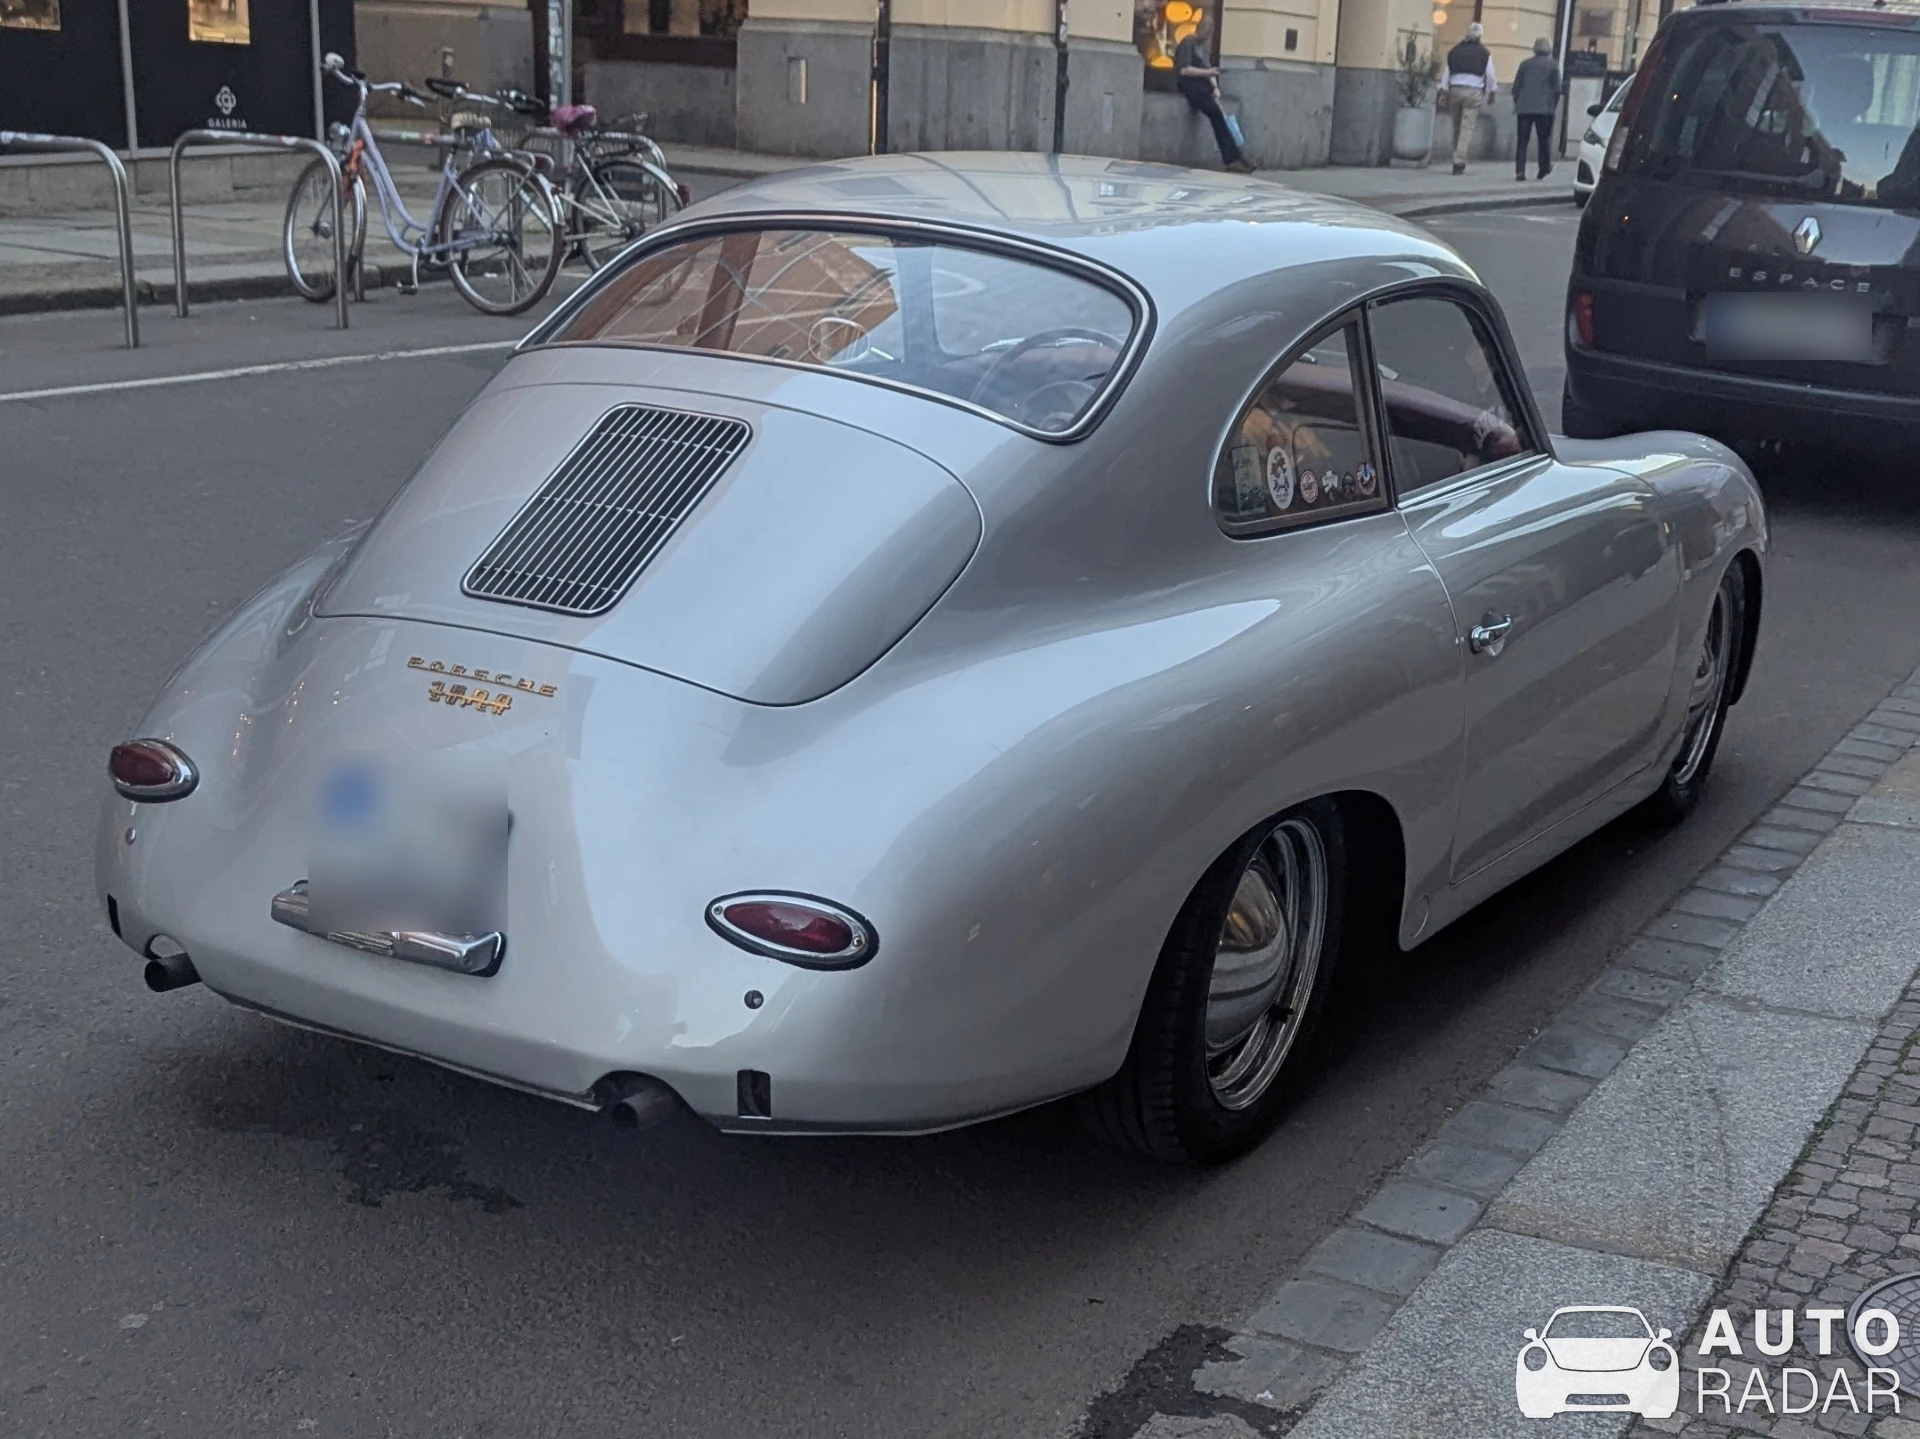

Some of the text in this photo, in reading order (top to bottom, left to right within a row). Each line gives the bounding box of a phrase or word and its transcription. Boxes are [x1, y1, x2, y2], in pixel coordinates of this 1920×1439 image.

[207, 117, 248, 129] GALERIA
[1728, 267, 1871, 292] ESPACE
[407, 656, 558, 697] PORSCHE
